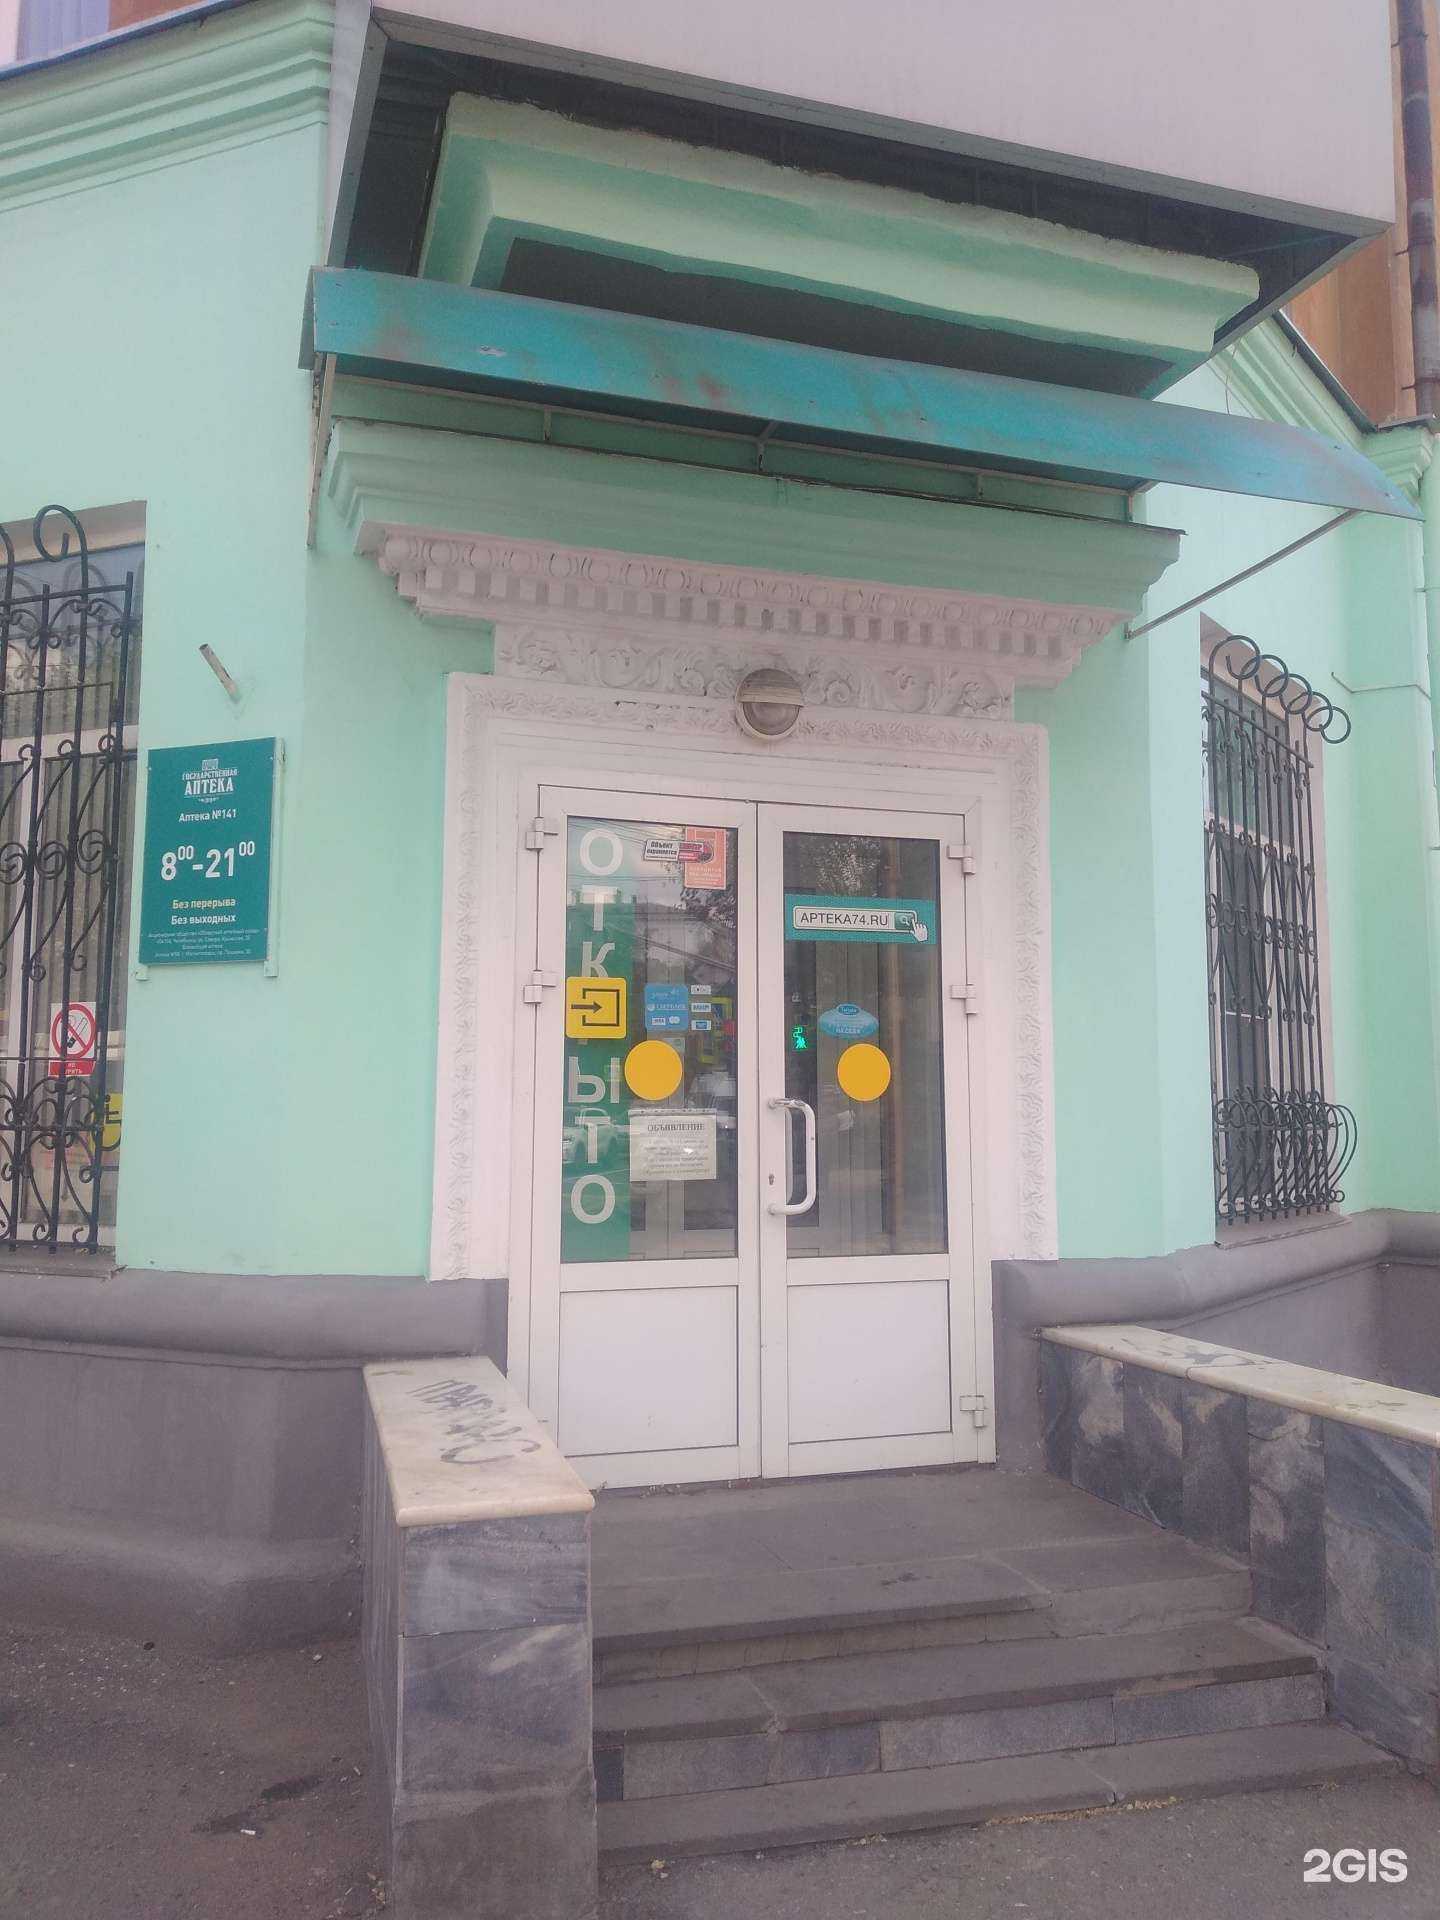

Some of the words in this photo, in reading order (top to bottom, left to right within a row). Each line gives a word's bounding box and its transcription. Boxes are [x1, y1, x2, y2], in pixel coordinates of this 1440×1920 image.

[184, 777, 234, 796] АПТЕКА
[179, 812, 210, 823] Аптека
[211, 809, 237, 820] №141
[172, 899, 189, 910] Без
[191, 898, 236, 910] перерыва
[171, 915, 188, 926] Без
[190, 914, 236, 925] выходных
[800, 912, 889, 926] APTEKA74.RU
[567, 828, 625, 1224] ОТКЫТО
[647, 1123, 705, 1132] ОБЪЯВЛЕНИЕ
